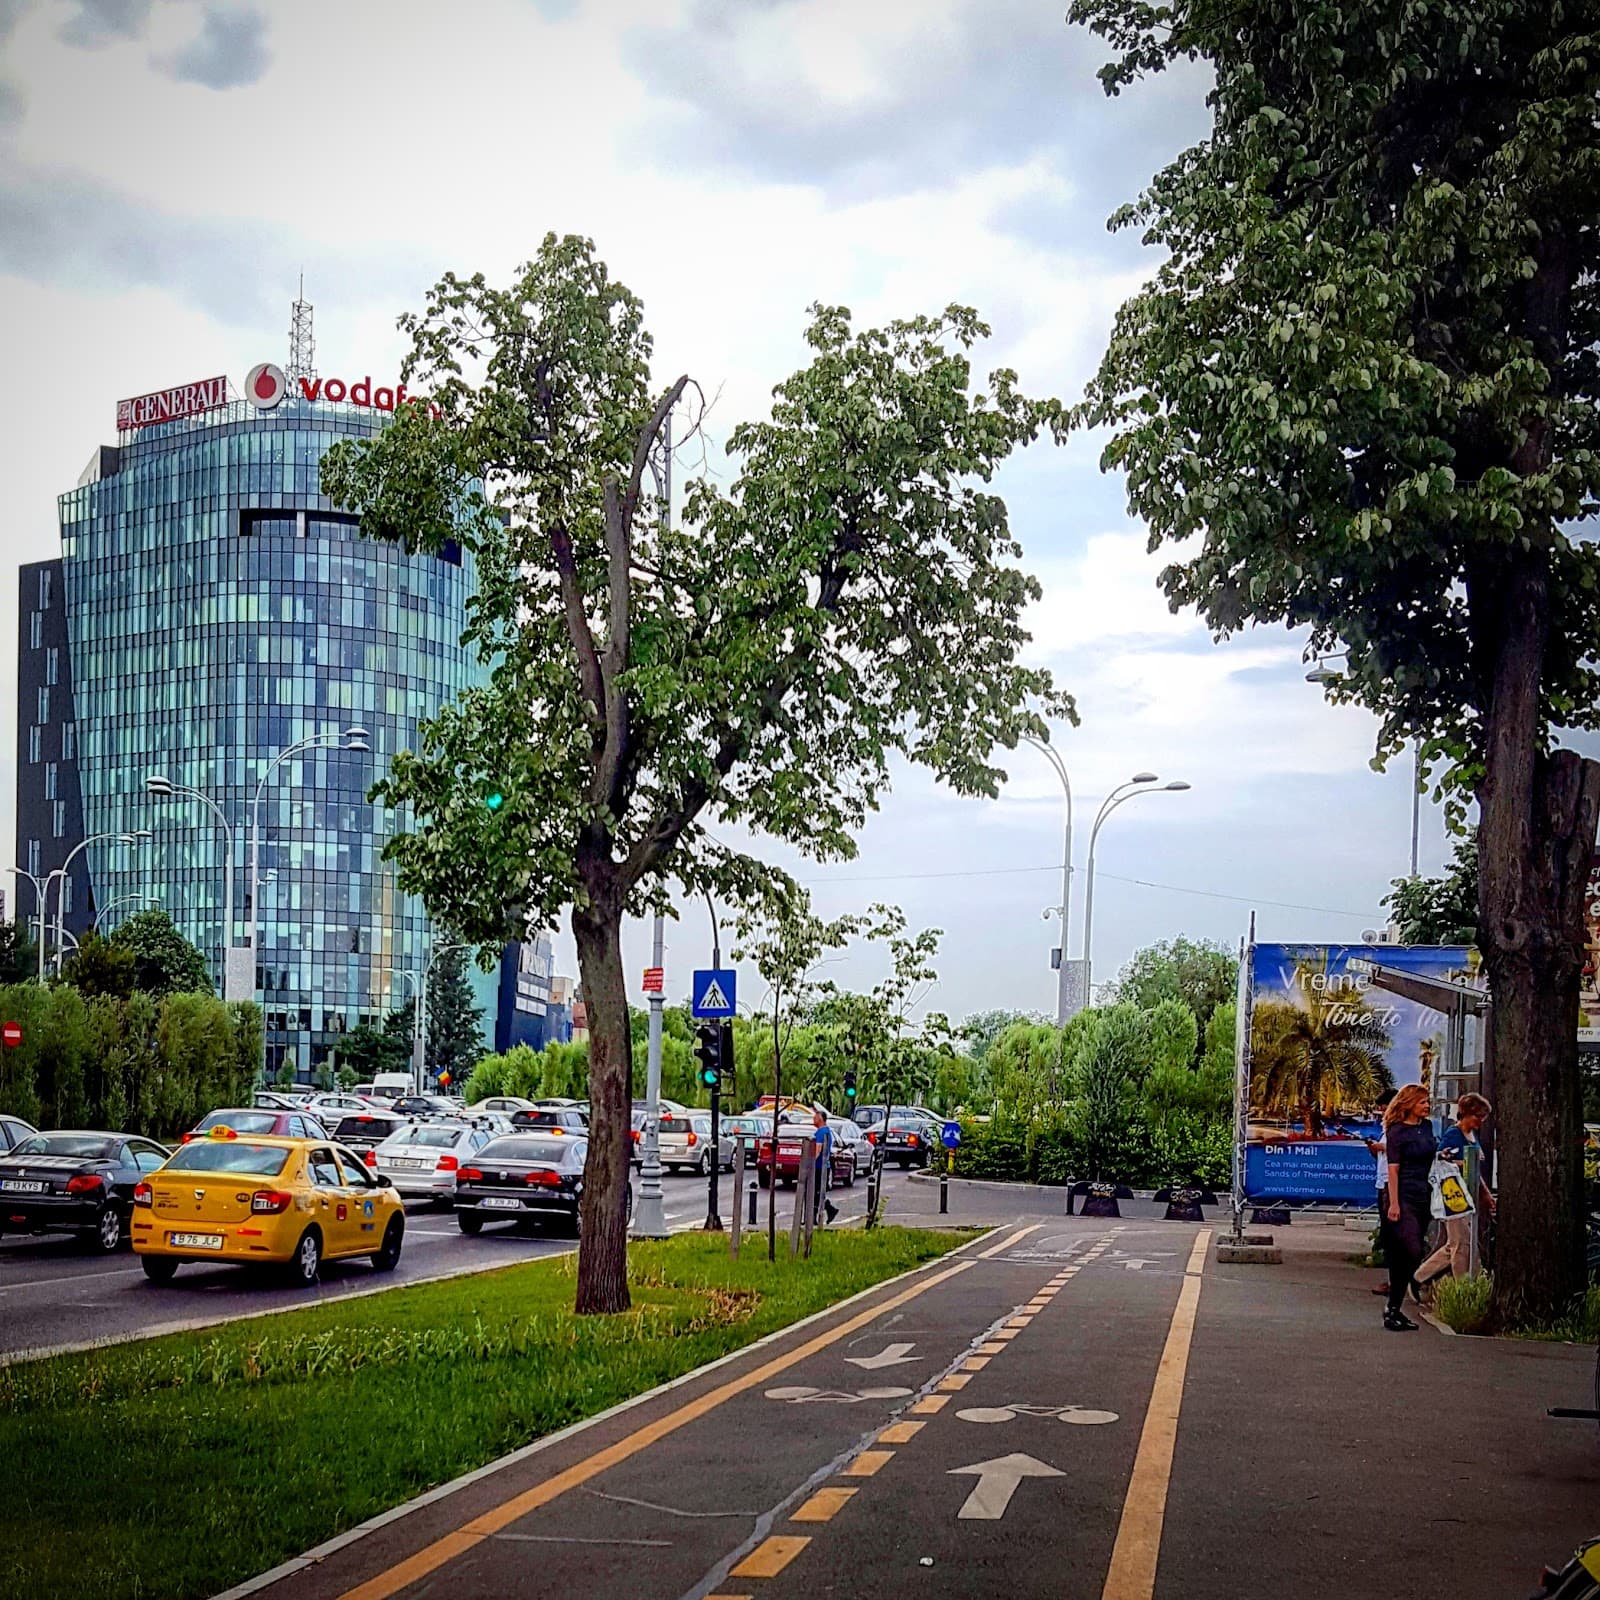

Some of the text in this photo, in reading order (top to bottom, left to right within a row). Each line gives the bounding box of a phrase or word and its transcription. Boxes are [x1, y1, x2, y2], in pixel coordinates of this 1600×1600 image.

[131, 378, 225, 424] GENERALI
[1279, 966, 1370, 992] Vreme
[1322, 1001, 1373, 1029] Time
[1374, 1005, 1405, 1028] to
[1265, 1145, 1318, 1156] Din 1 Mai!
[1264, 1169, 1290, 1178] Sands
[1291, 1170, 1301, 1178] of
